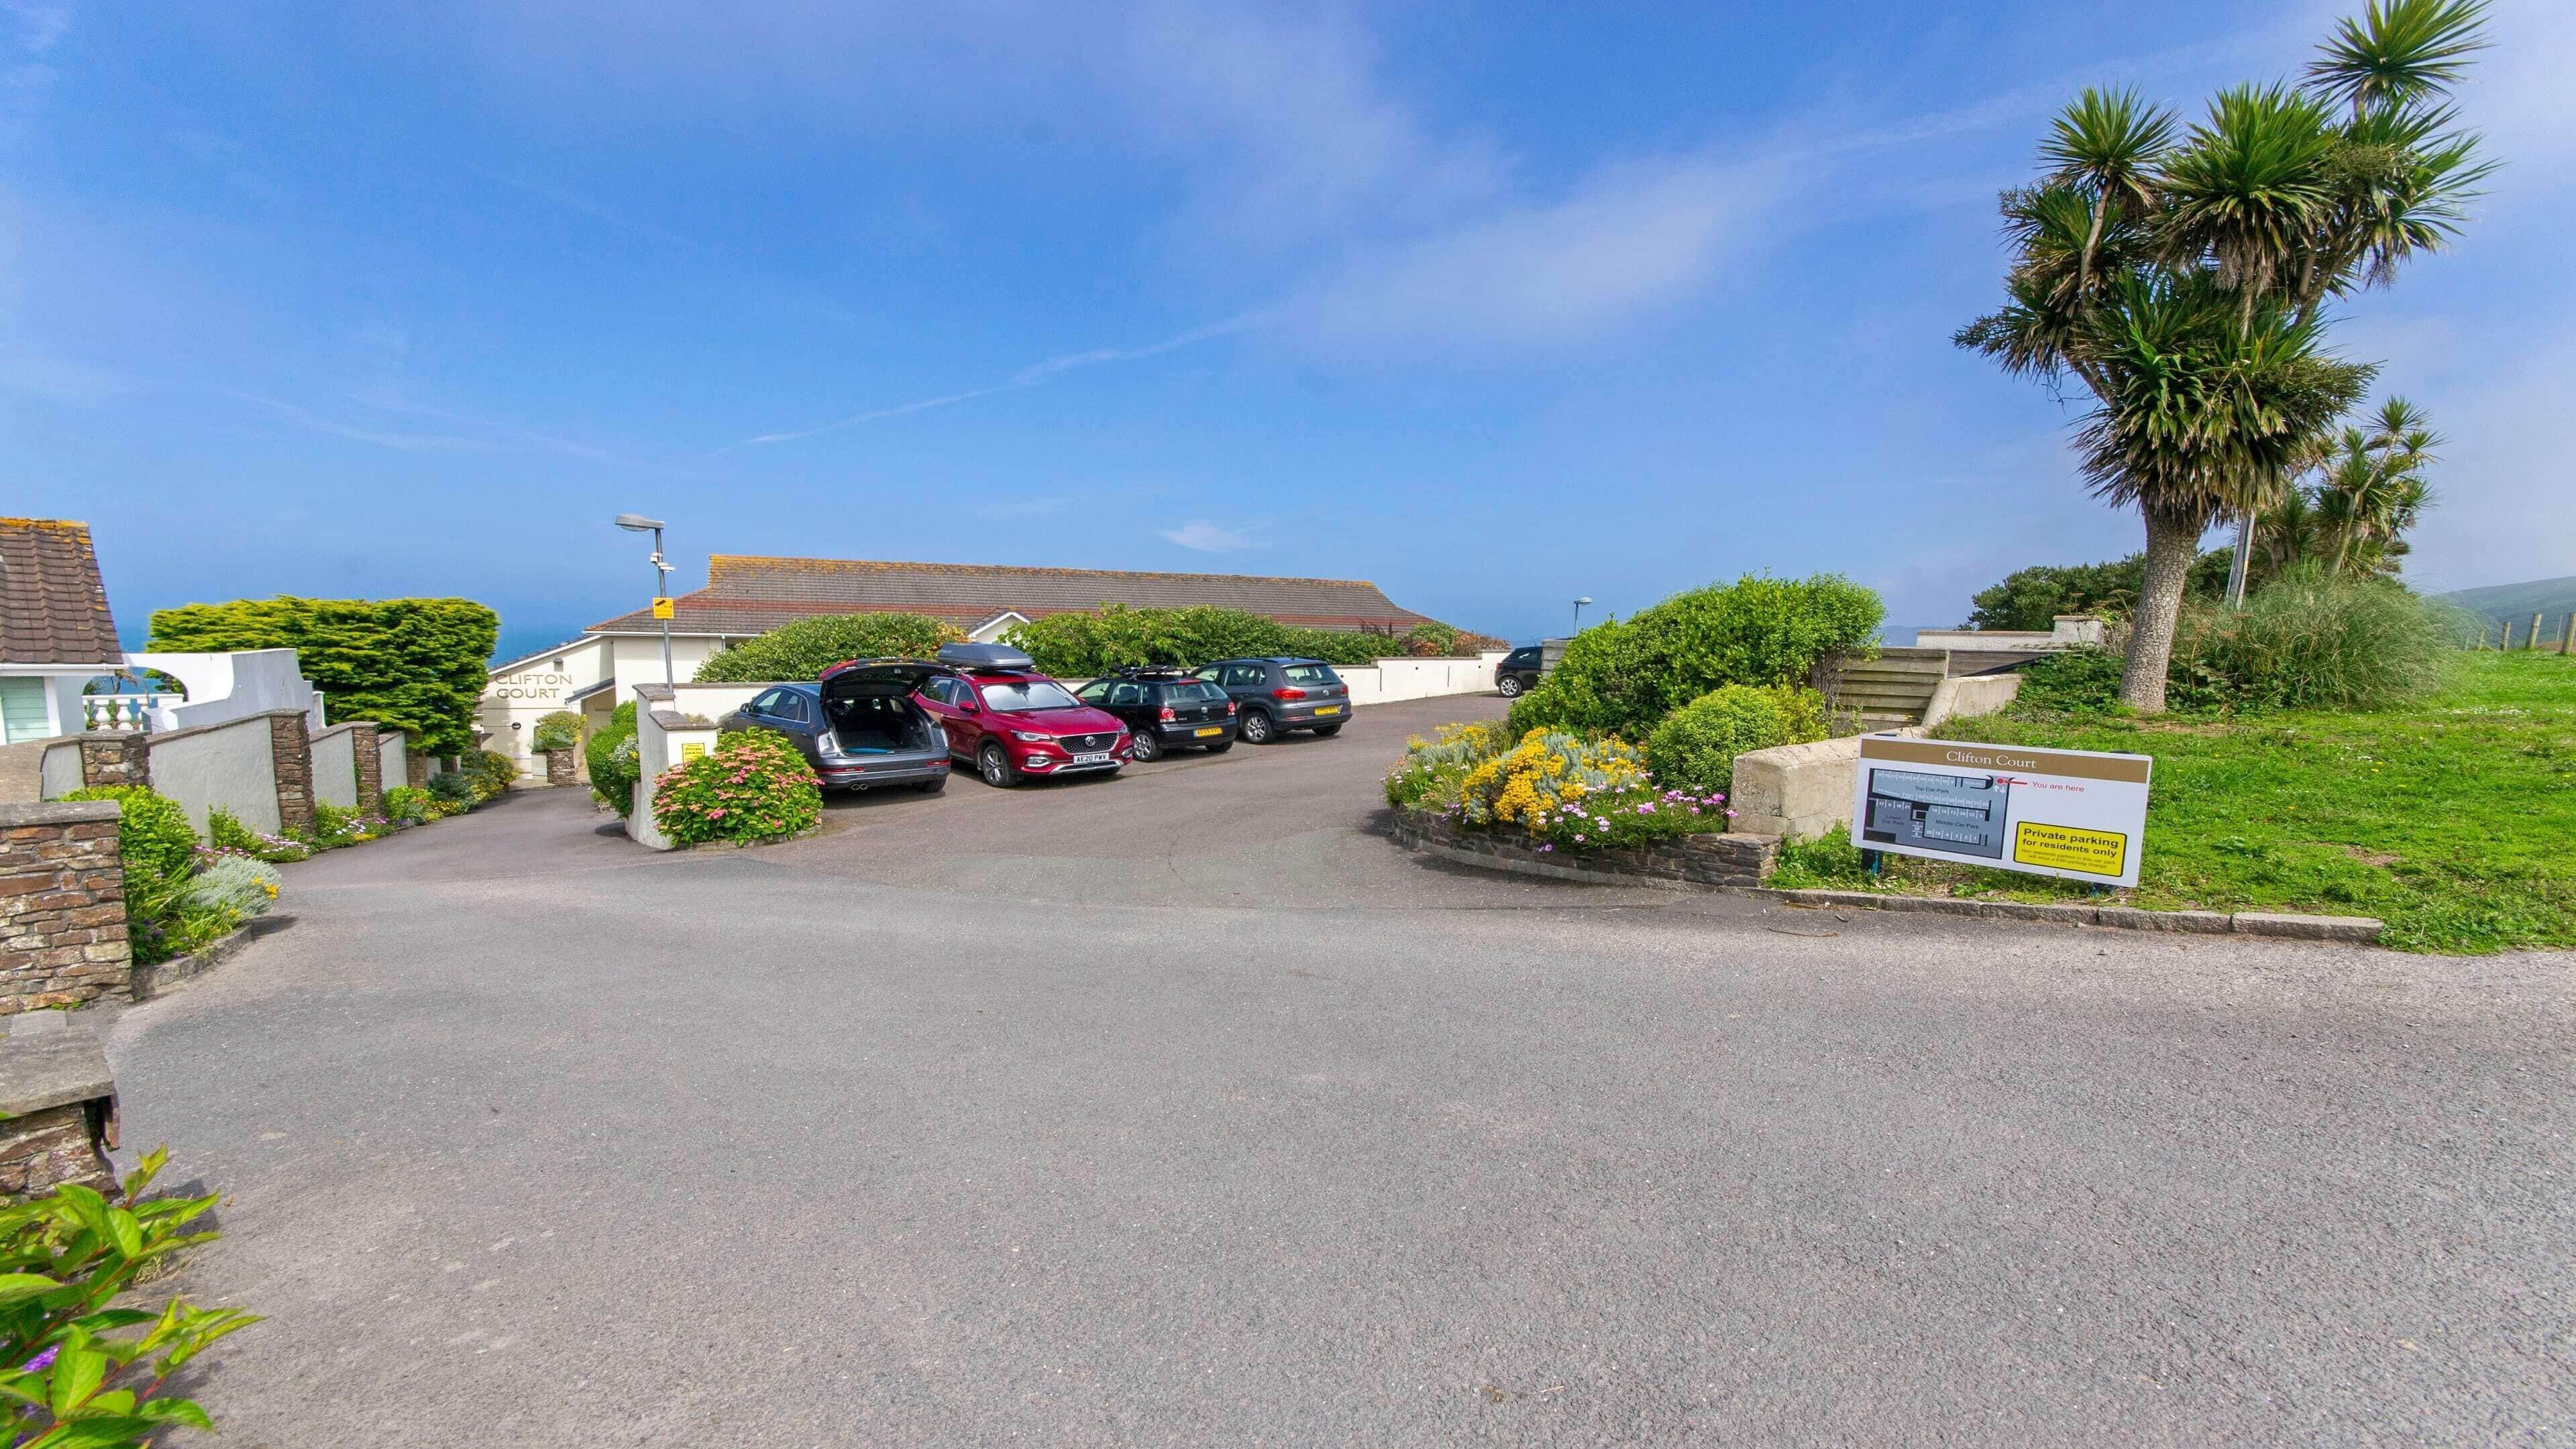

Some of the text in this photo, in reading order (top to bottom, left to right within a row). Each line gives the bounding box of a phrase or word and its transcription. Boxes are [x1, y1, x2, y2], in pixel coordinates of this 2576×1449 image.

[495, 674, 572, 684] CLIFTON
[496, 688, 559, 698] COURT
[1946, 751, 2037, 769] Clifton Court
[2023, 828, 2118, 849] Private parking
[2040, 842, 2089, 853] residents
[2092, 849, 2117, 858] only
